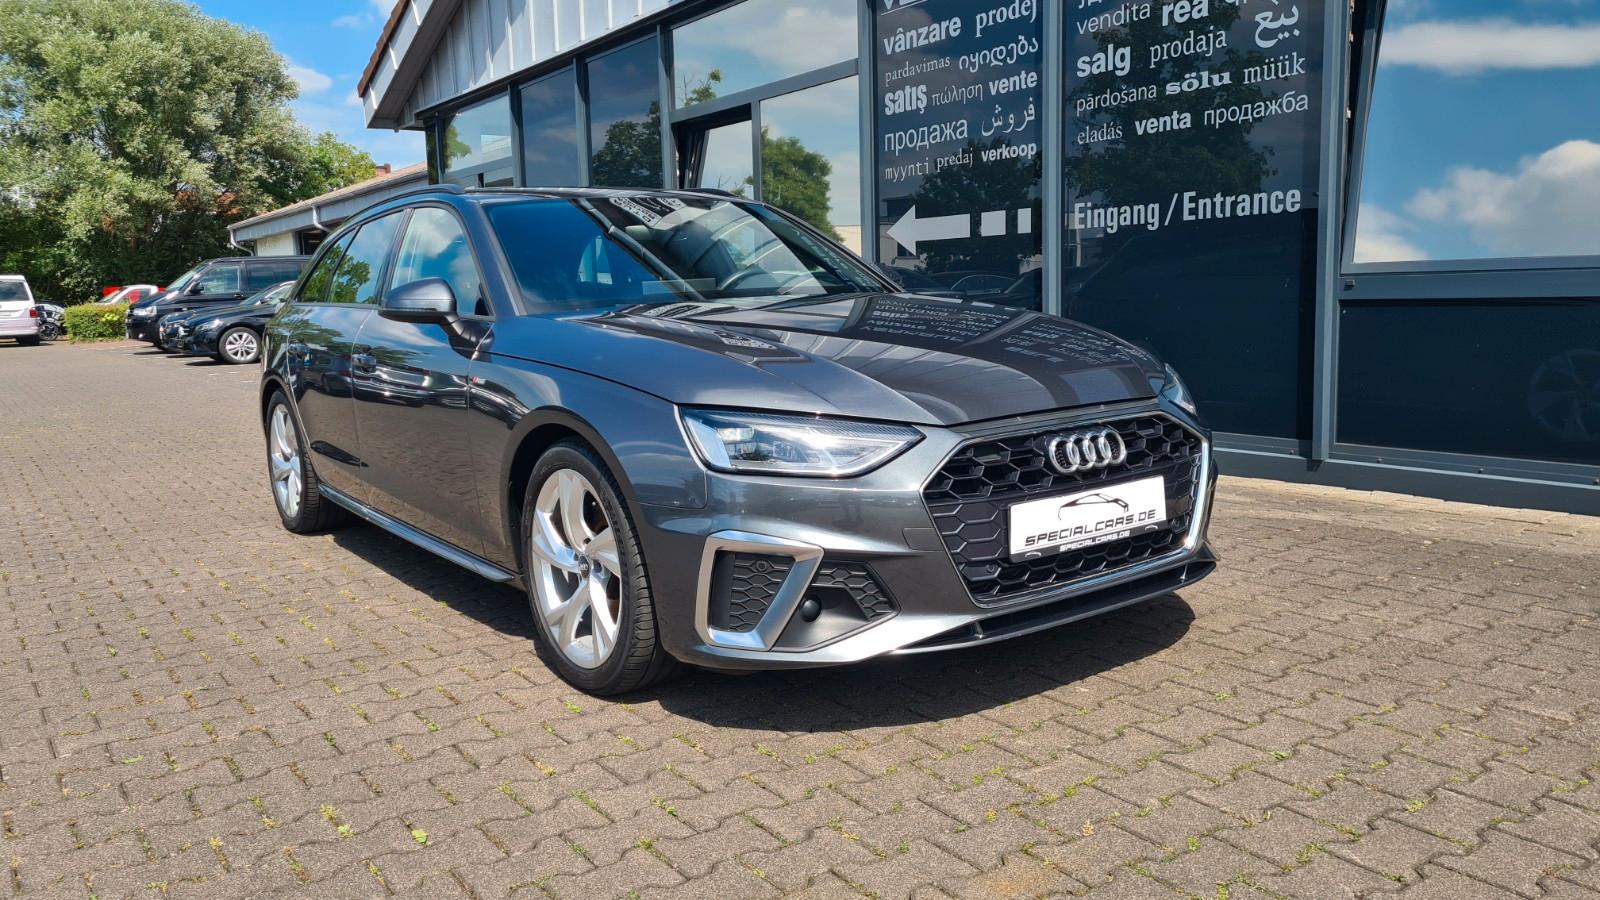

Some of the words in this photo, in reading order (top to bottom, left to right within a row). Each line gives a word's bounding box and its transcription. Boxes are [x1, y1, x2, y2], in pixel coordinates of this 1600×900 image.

[883, 16, 962, 55] vânzare
[975, 0, 1037, 38] prodej
[1076, 3, 1151, 35] vendita
[1076, 43, 1131, 77] salg
[1149, 25, 1228, 69] prodaja
[885, 56, 951, 87] pardavimas
[988, 70, 1038, 96] vente
[1076, 84, 1157, 117] pārdošana
[1165, 70, 1233, 96] sölu
[1243, 51, 1306, 85] müük
[884, 83, 928, 115] satış
[931, 83, 983, 106] πώληση
[1203, 90, 1309, 129] продажба
[884, 119, 969, 156] продажа
[1077, 122, 1123, 145] eladás
[1134, 110, 1192, 136] venta
[885, 159, 929, 183] myynti
[936, 147, 973, 172] predaj
[981, 142, 1037, 162] verkoop
[1025, 509, 1156, 547] SPECIALCARS.DE
[1059, 530, 1130, 552] SPECIALCARS.DE
